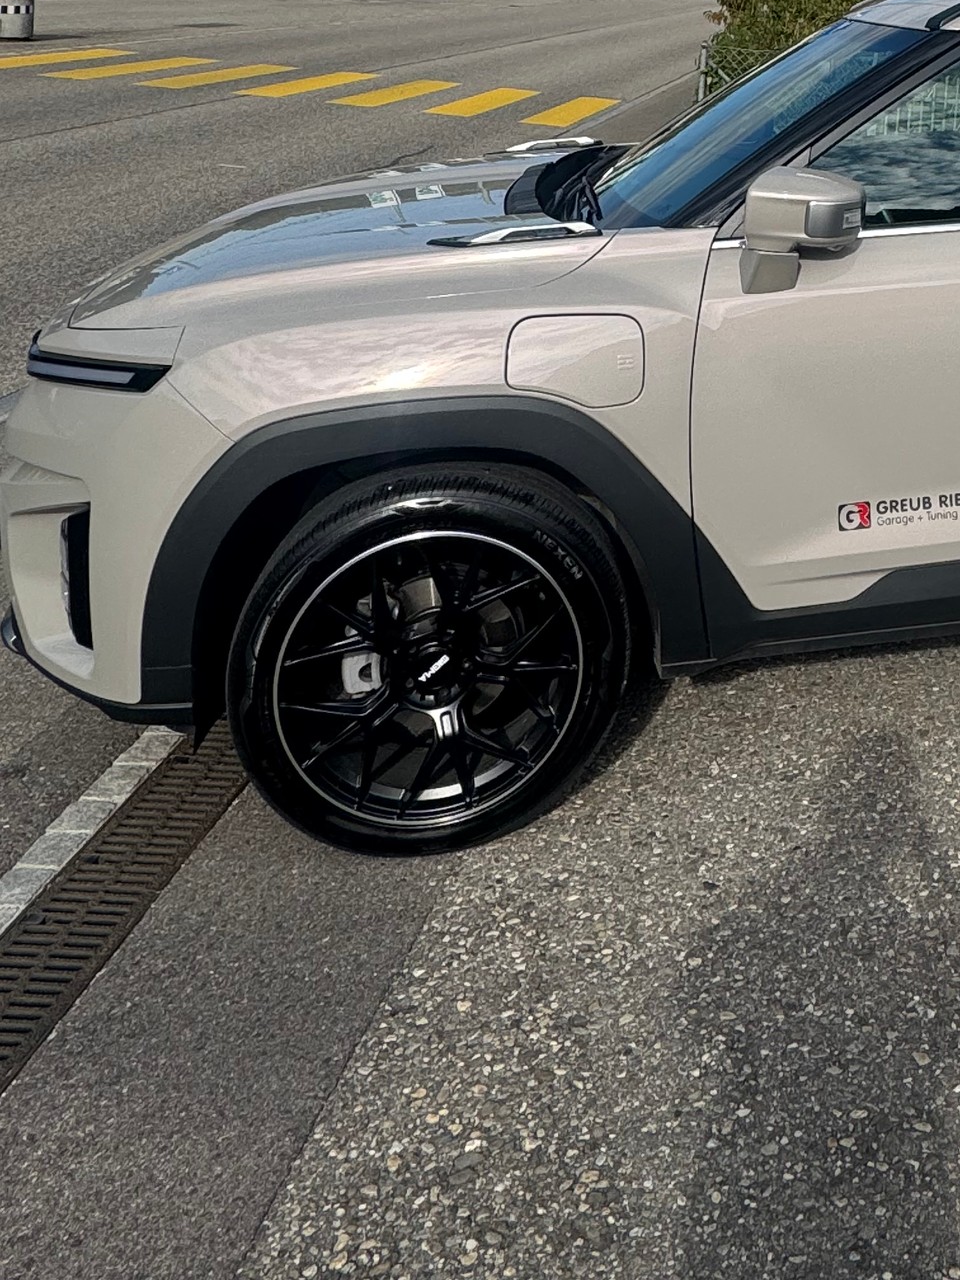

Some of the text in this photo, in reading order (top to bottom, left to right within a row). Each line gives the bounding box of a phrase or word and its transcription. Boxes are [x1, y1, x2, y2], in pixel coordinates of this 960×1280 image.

[840, 503, 870, 529] GR
[876, 496, 932, 514] GREUB
[876, 515, 914, 527] Garage
[926, 510, 958, 521] Tuning
[532, 530, 583, 579] NEXEN
